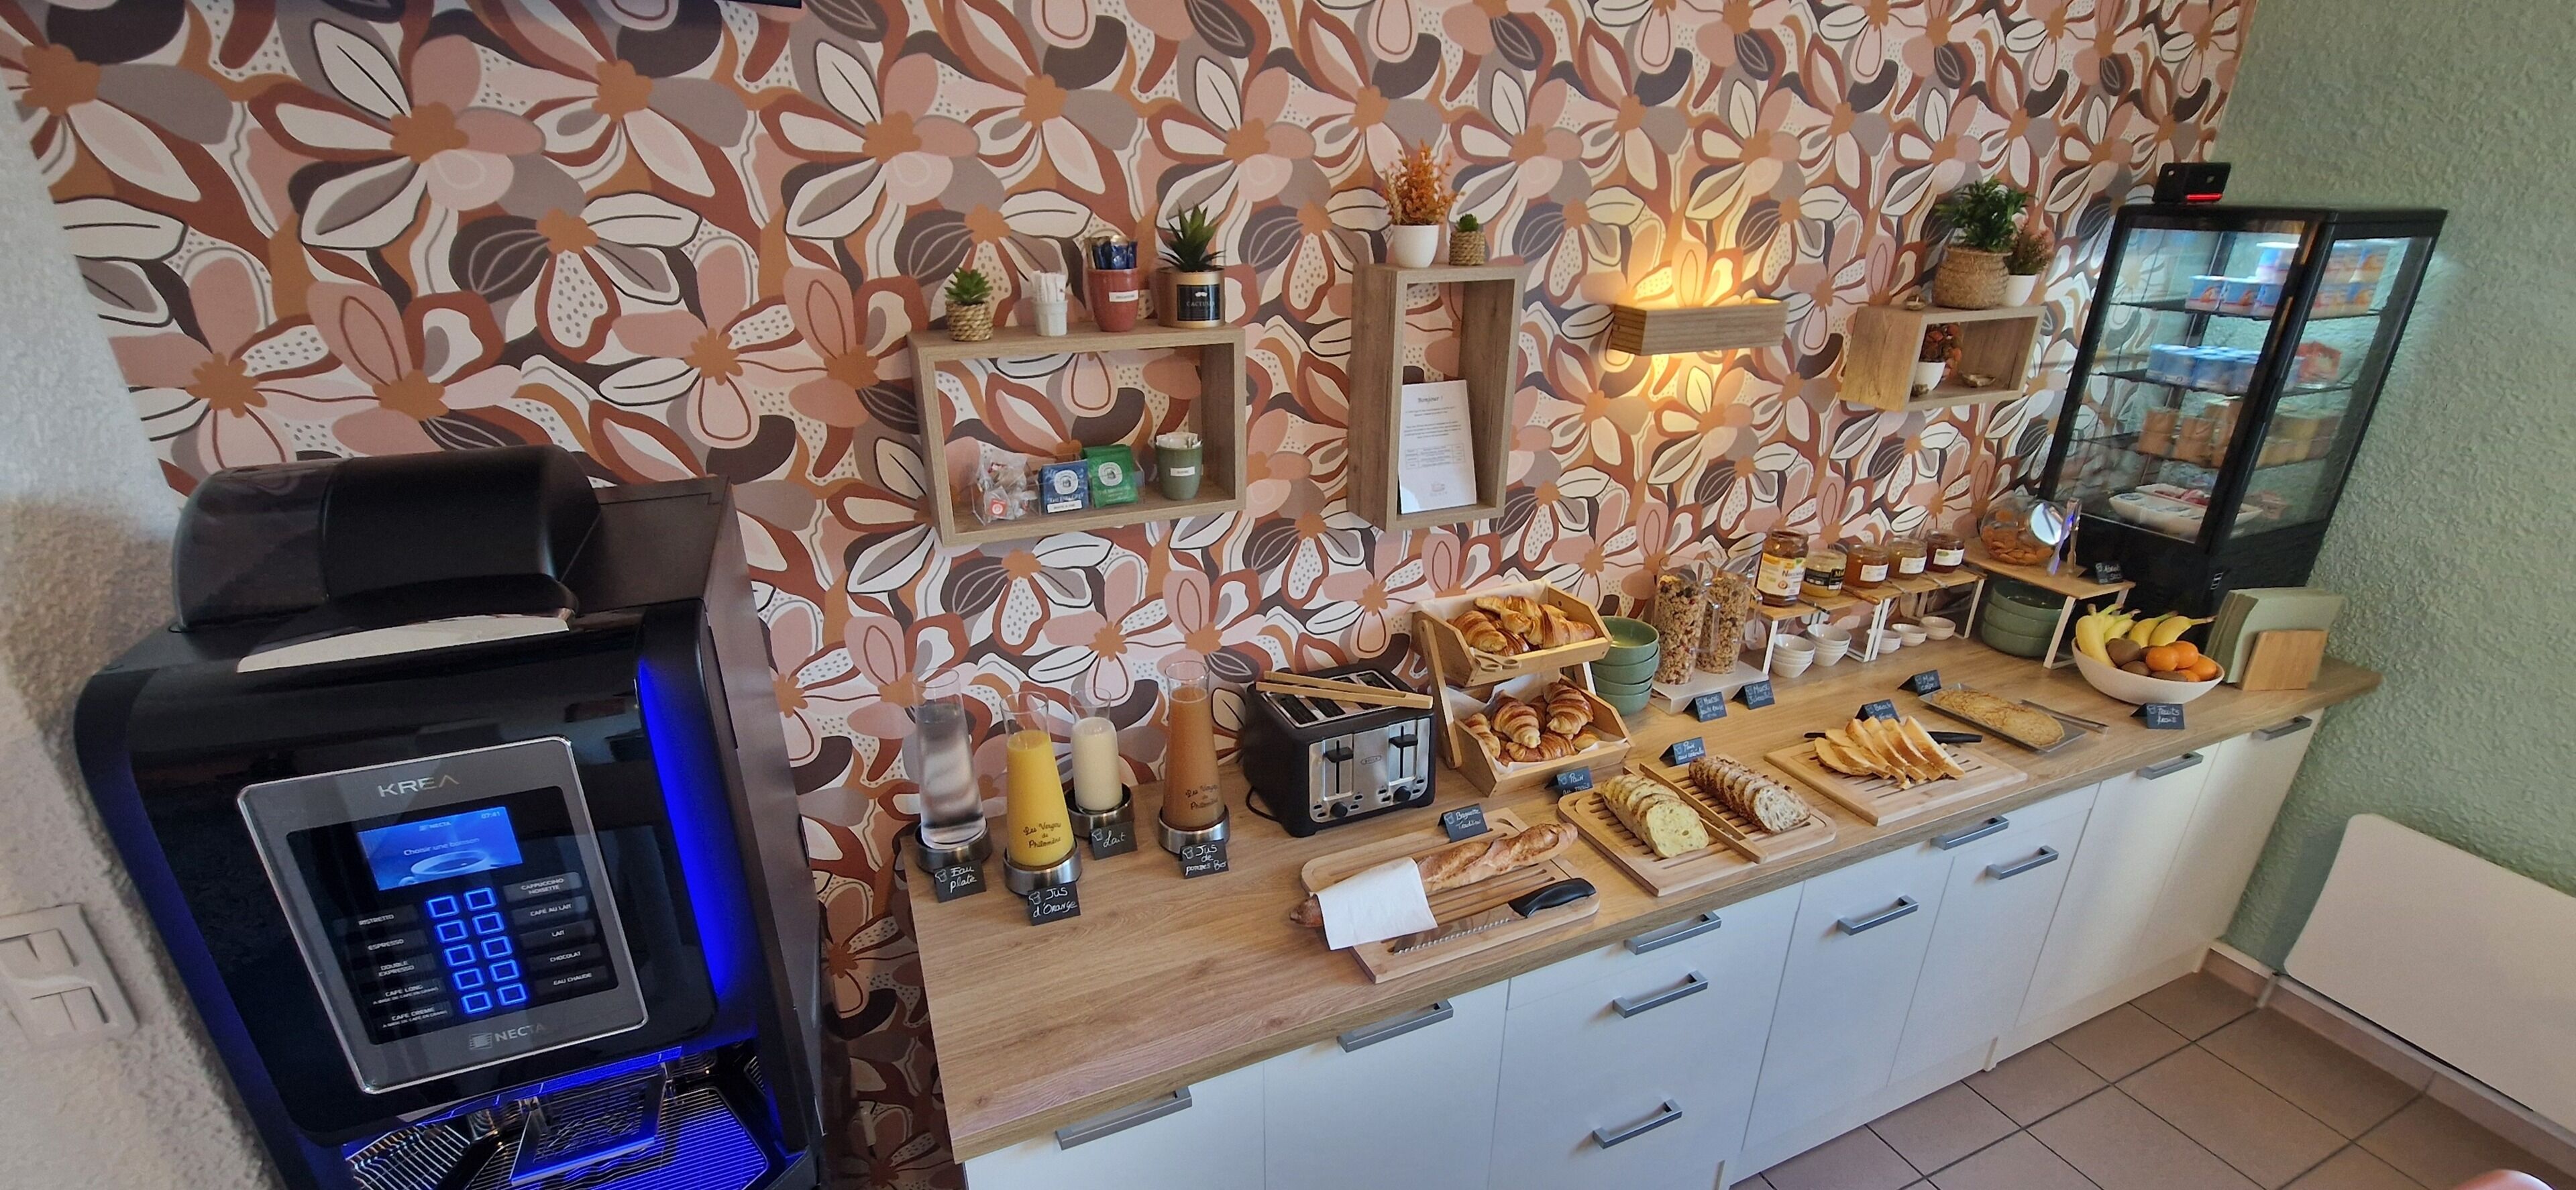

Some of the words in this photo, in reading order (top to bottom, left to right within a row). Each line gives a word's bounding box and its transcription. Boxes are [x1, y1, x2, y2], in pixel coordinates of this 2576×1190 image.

[1417, 396, 1440, 404] Bonjour
[1569, 772, 1584, 784] Pain
[378, 774, 460, 798] KREA
[481, 811, 501, 820] 07:41
[429, 821, 452, 830] NECTA
[1103, 830, 1126, 849] Lait
[403, 845, 431, 857] Choisir
[433, 843, 448, 851] une
[1195, 844, 1218, 857] Jus
[1201, 854, 1214, 863] de
[950, 865, 975, 878] Eau
[521, 877, 564, 891] CAPPUCCINO
[949, 875, 977, 894] plate
[1044, 887, 1069, 901] Jus
[558, 903, 572, 911] LAIT
[1033, 900, 1078, 918] d'Orange
[358, 914, 394, 926] RISTRETTO
[549, 951, 582, 963] CHOCOLAT
[380, 961, 409, 971] DOUBLE
[553, 977, 566, 985] EAU
[567, 973, 592, 983] CHAUDE
[404, 983, 424, 993] LONG
[494, 1023, 546, 1042] NECTA
